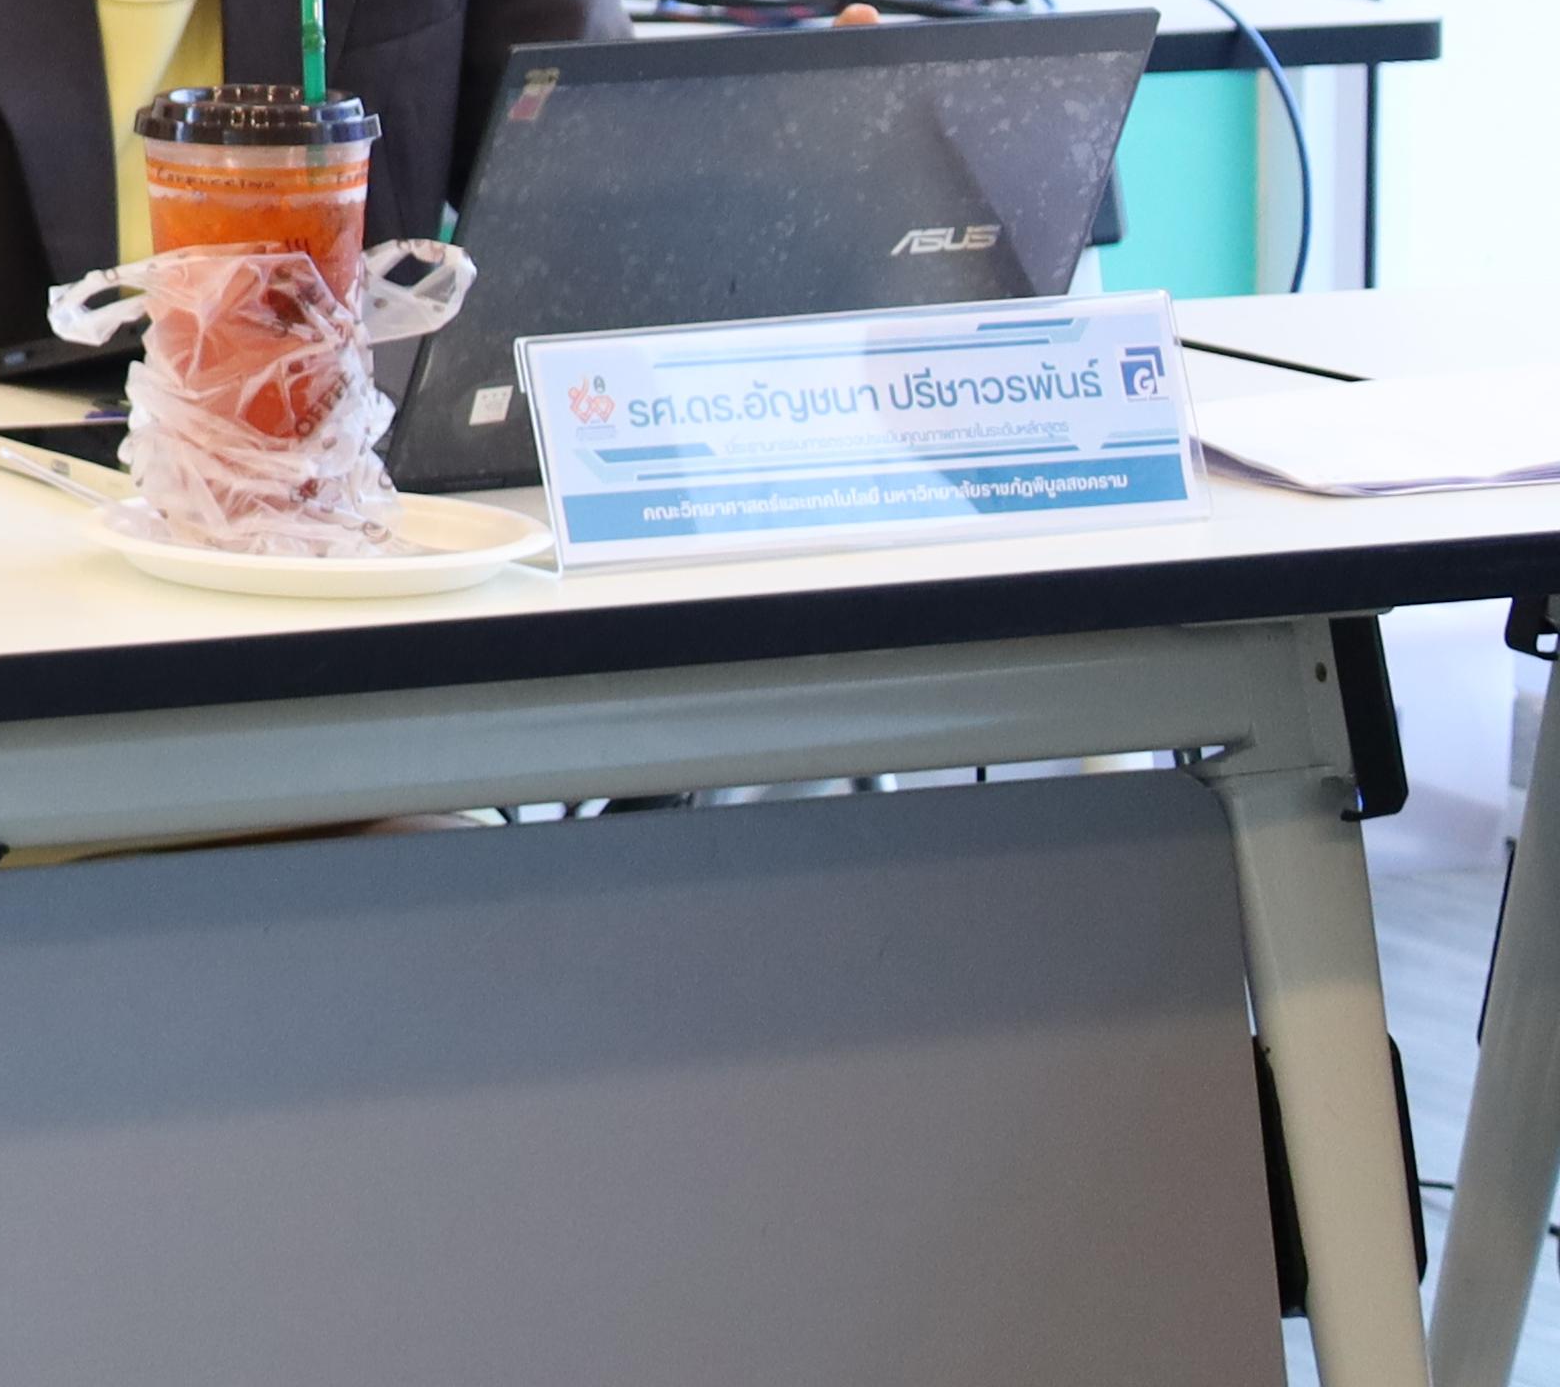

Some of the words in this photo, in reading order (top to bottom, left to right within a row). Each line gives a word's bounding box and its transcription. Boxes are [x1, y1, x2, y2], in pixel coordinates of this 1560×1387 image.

[890, 225, 1001, 255] ASUS
[628, 379, 880, 429] รศ.ดร.อัญชนา
[889, 358, 1103, 412] ปรีชาวรพันธ์
